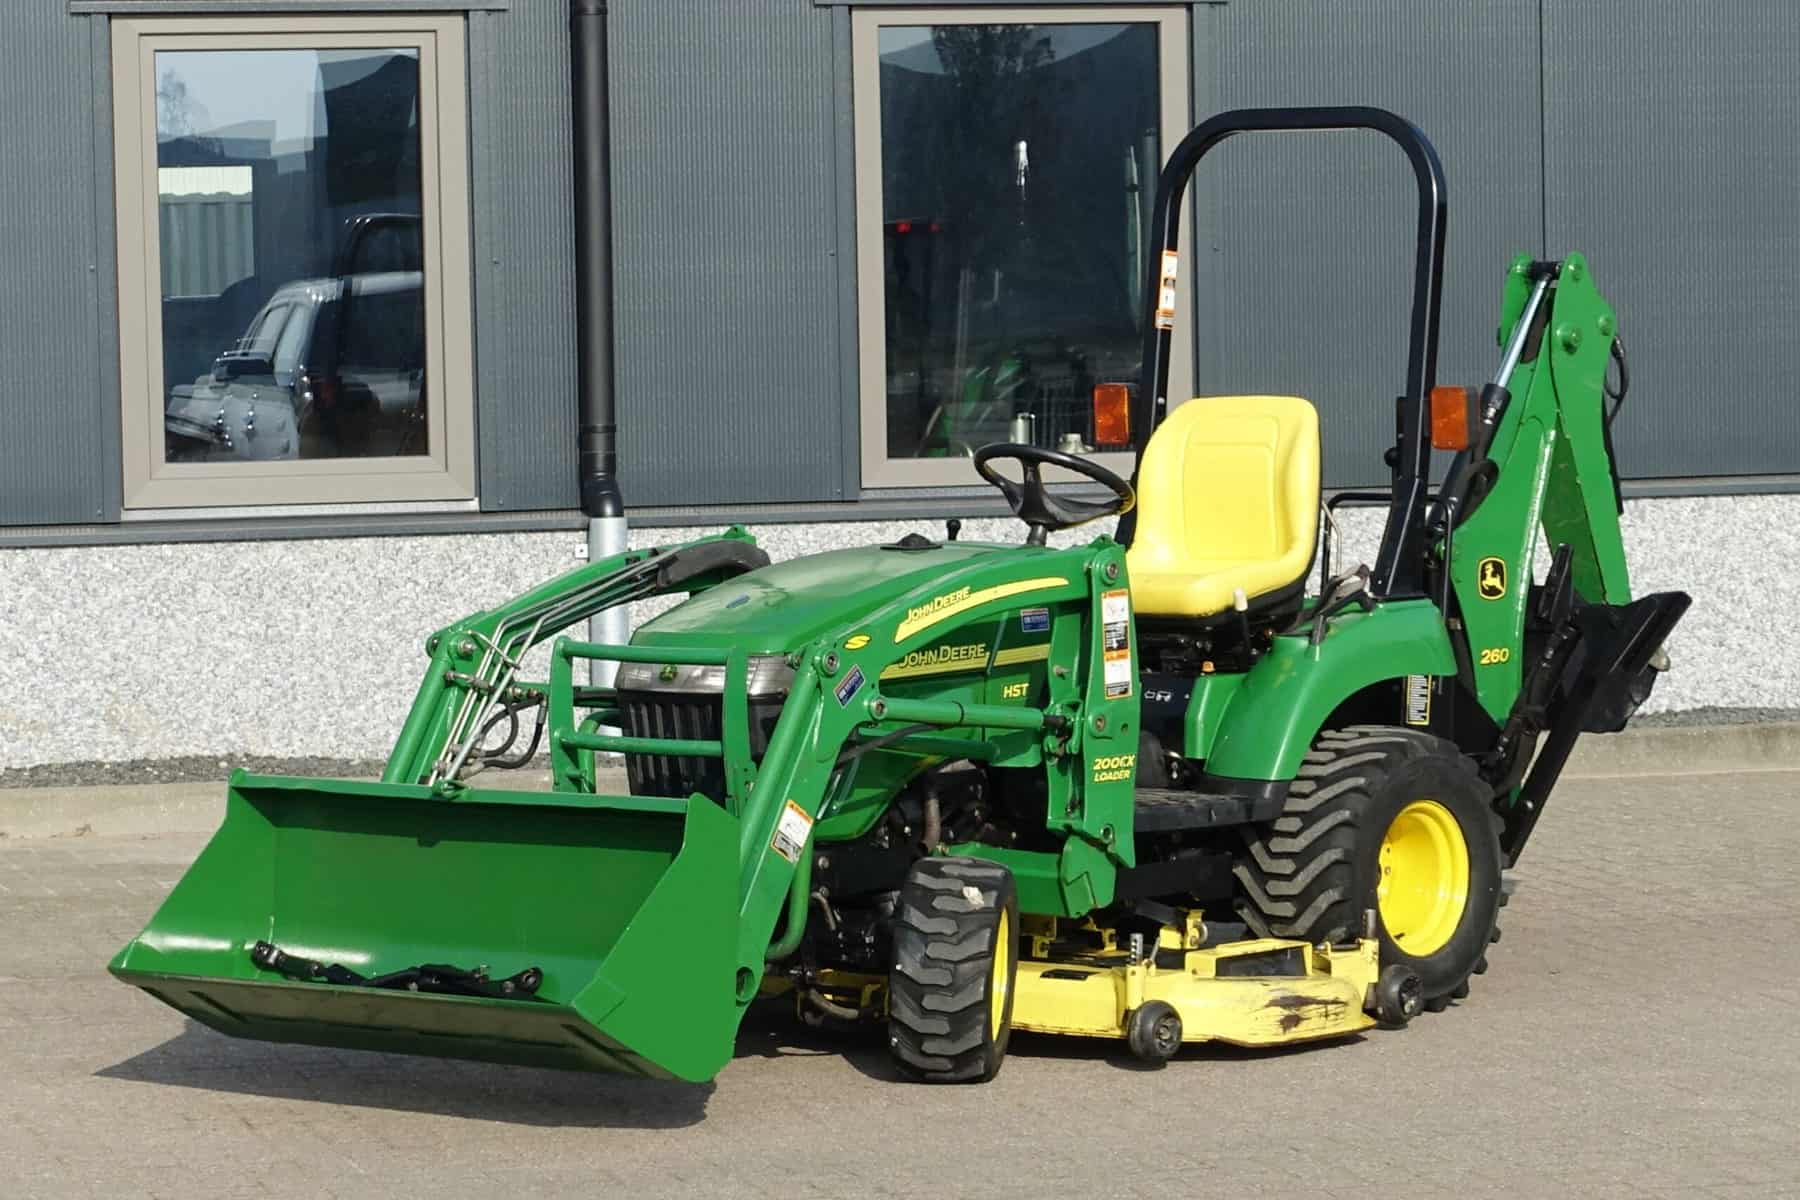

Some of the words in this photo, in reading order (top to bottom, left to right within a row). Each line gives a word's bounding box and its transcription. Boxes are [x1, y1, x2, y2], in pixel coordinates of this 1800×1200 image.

[906, 604, 934, 624] JOHN
[934, 586, 971, 610] DEERE
[899, 650, 938, 668] JOHN
[938, 643, 987, 663] DEERE
[1480, 647, 1509, 665] 260
[1003, 683, 1029, 698] HST
[1093, 754, 1135, 770] 200CX
[1094, 769, 1131, 783] LOADER
